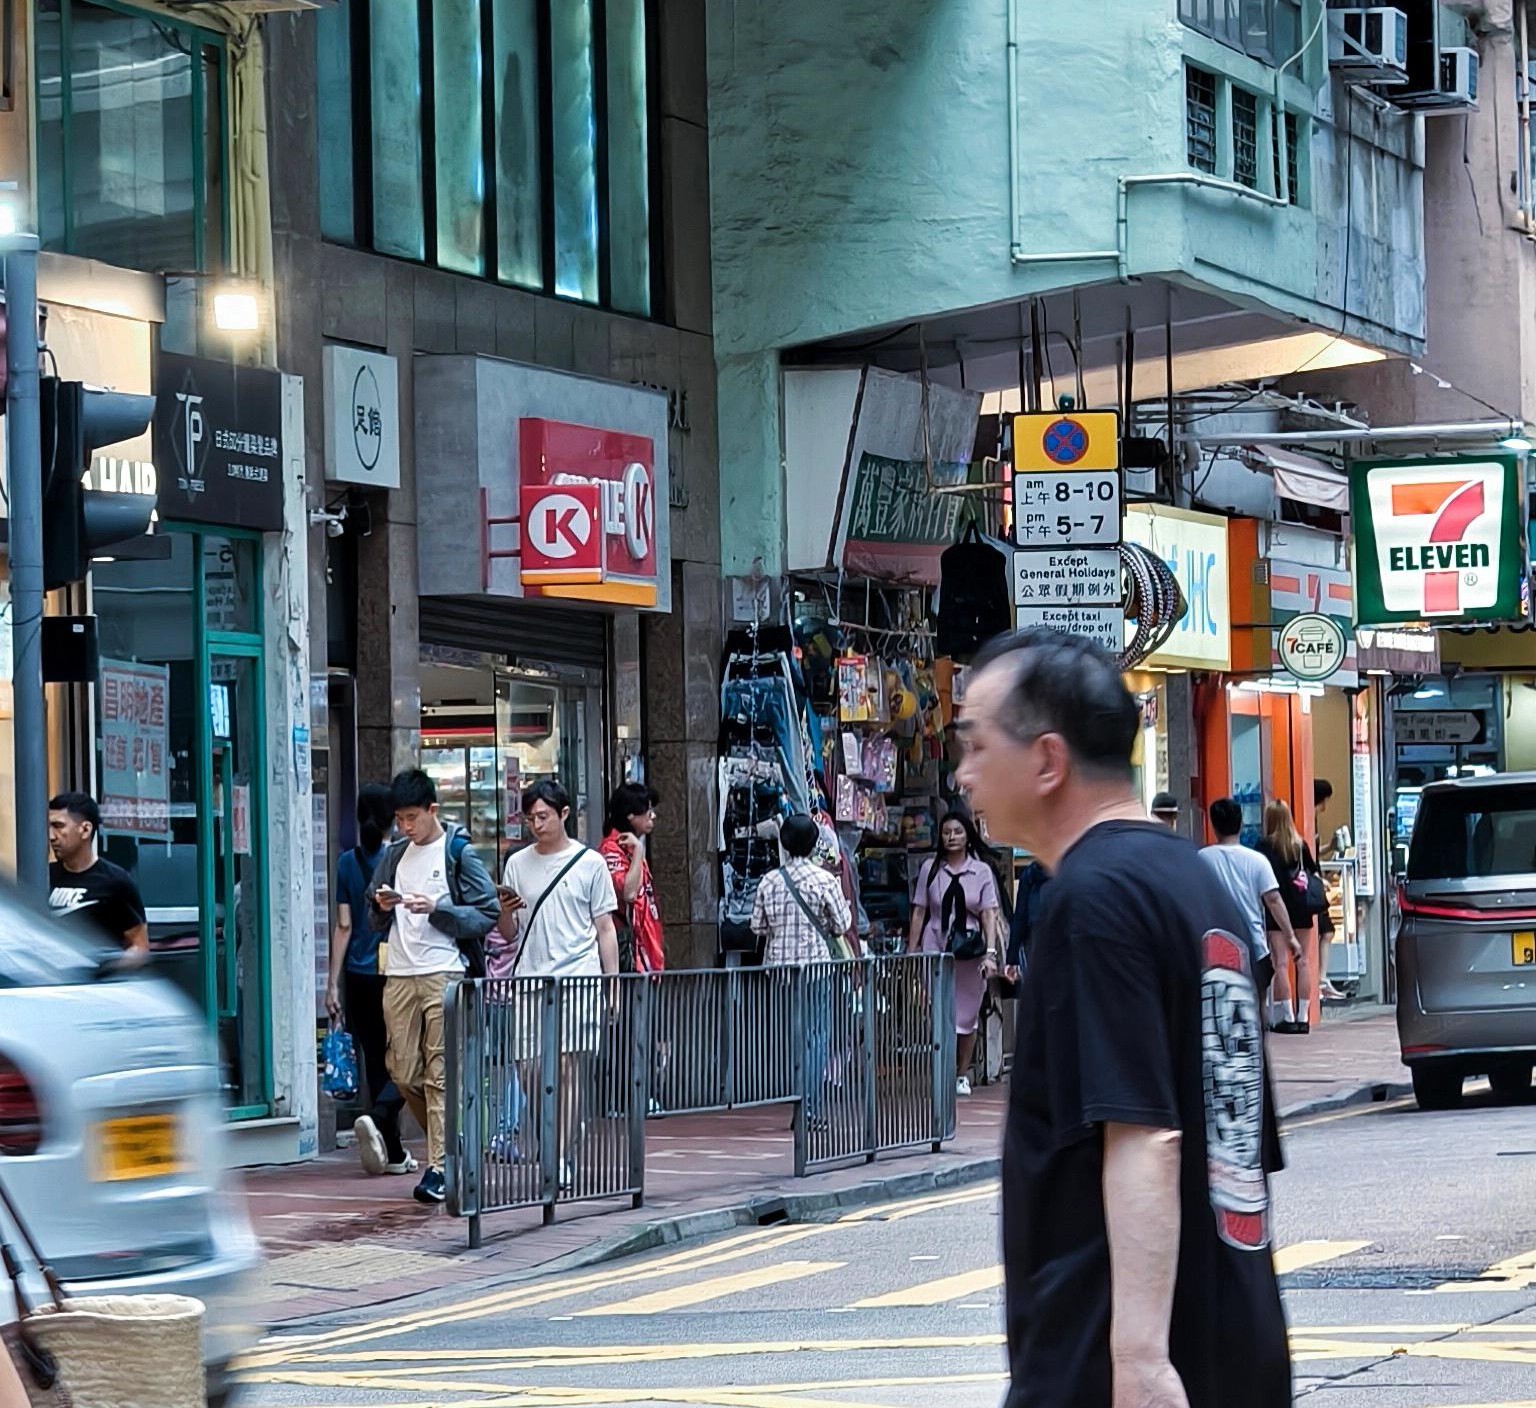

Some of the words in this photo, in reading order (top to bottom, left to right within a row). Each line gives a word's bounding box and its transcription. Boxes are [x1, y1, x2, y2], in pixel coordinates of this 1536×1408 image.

[1026, 479, 1044, 489] am
[1055, 480, 1114, 502] 8-10
[1020, 491, 1051, 505] 上午
[1026, 513, 1045, 524] pm
[545, 507, 584, 551] K
[1021, 525, 1051, 539] 下午
[1391, 479, 1485, 613] 7
[1049, 555, 1088, 568] Except
[1020, 568, 1066, 580] General
[1068, 567, 1116, 580] Holidays
[1042, 610, 1079, 622] Except
[1081, 610, 1101, 622] taxi
[1097, 622, 1113, 633] off
[49, 887, 88, 907] NIKE
